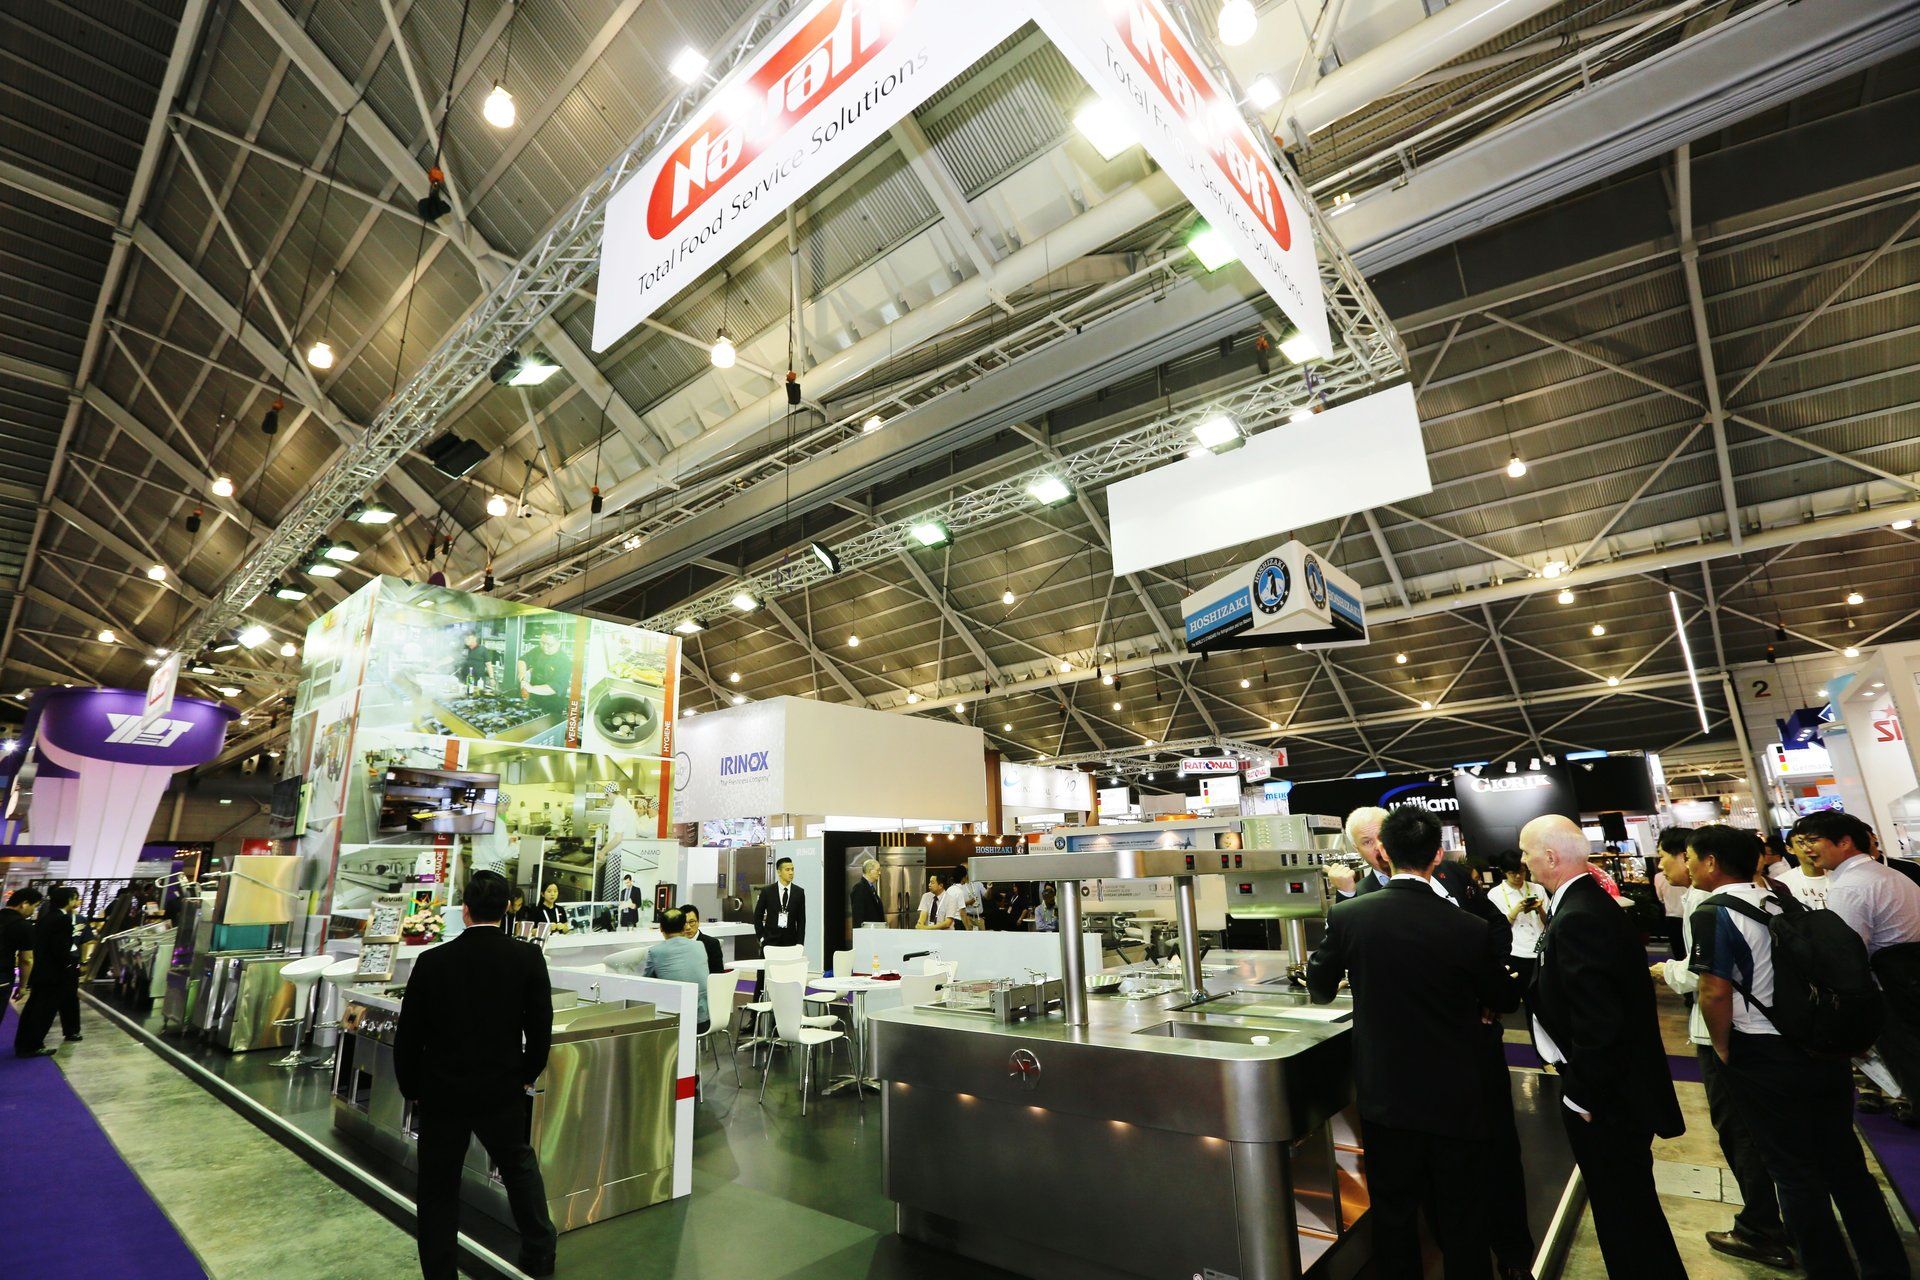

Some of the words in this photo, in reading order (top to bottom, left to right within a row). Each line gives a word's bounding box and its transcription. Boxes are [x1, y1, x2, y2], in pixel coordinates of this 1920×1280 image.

[639, 248, 674, 295] Total
[680, 208, 723, 262] Food
[731, 149, 804, 220] Service
[811, 46, 929, 154] Solutions
[1101, 37, 1148, 114] Total
[1200, 164, 1249, 239] Service
[1251, 228, 1303, 306] Solutions
[1255, 558, 1286, 583] HOSHIZAKI
[1189, 594, 1249, 633] HOSHIZAKI
[1752, 680, 1771, 698] 2
[568, 700, 579, 743] VERSATILE
[663, 720, 672, 752] HYGIENE
[720, 750, 769, 776] IRINOX
[1184, 760, 1235, 771] RATIONAL
[1470, 774, 1551, 793] GIORIK
[975, 846, 1013, 854] HOSHIZAKI
